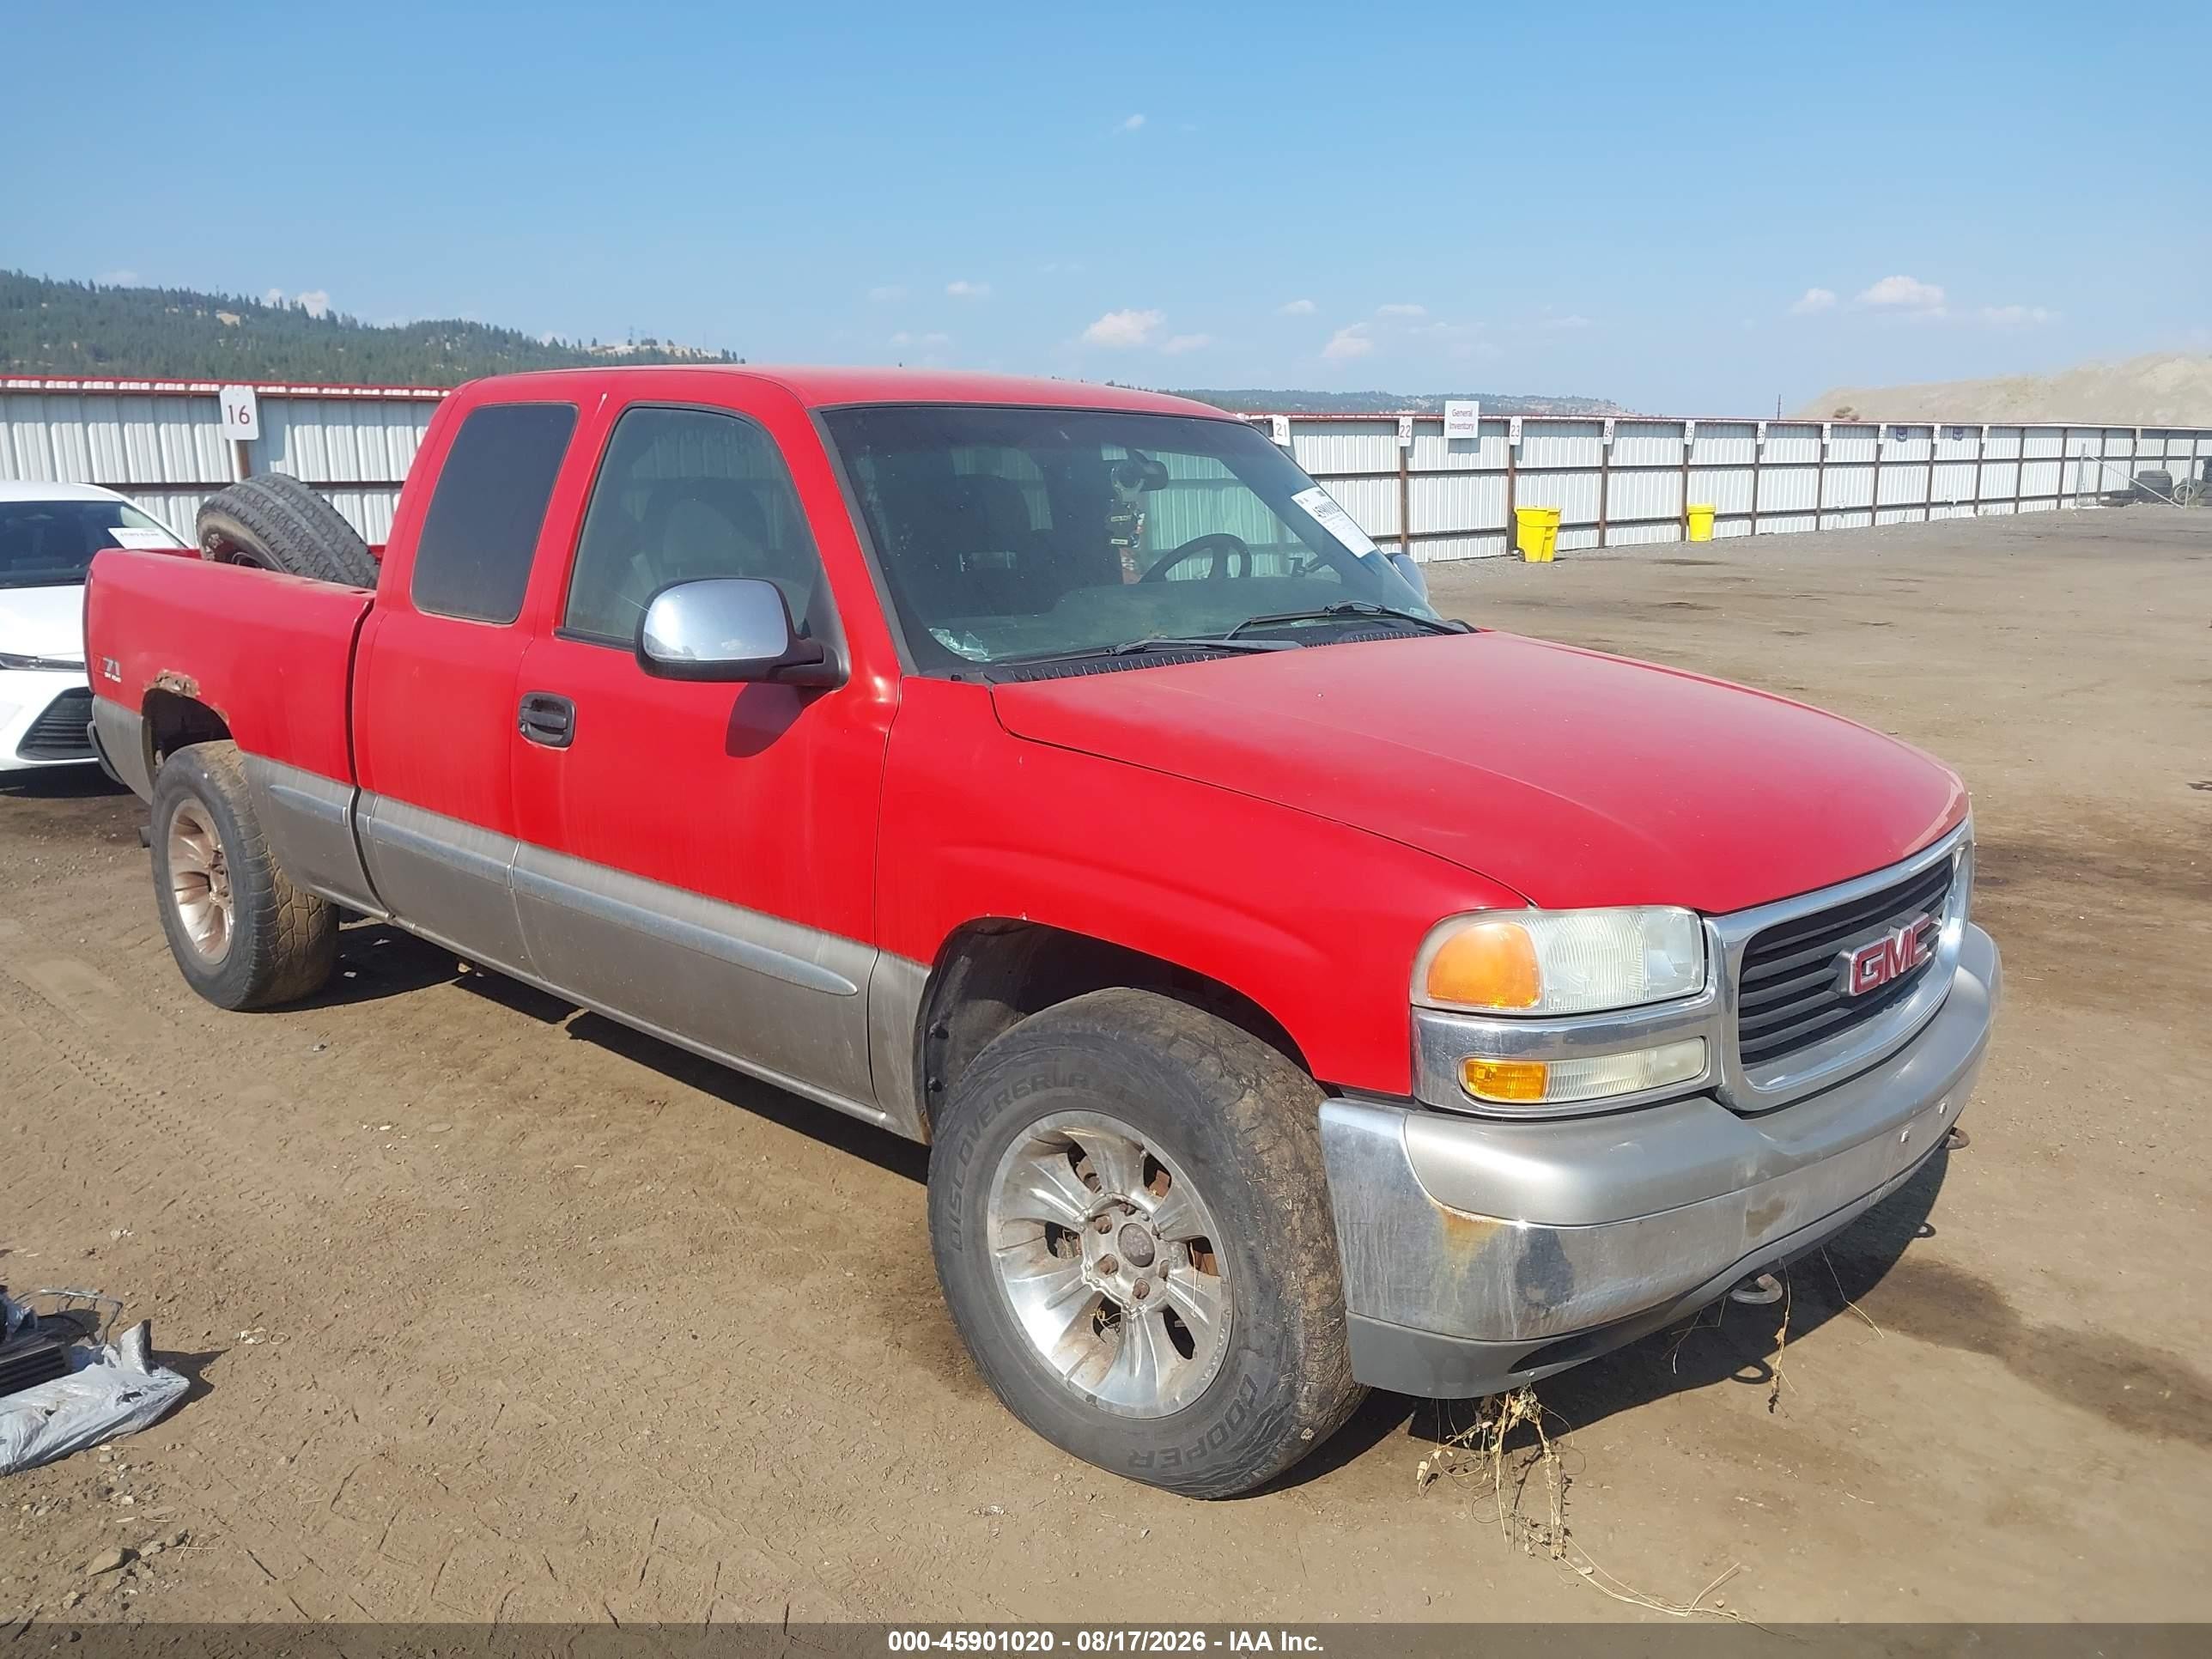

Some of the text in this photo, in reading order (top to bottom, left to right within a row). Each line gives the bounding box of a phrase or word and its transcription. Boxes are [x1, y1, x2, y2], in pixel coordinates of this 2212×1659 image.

[228, 404, 251, 425] 16
[1451, 409, 1474, 417] General
[1275, 422, 1287, 438] 21
[1400, 424, 1411, 438] 22
[1449, 422, 1475, 432] Inventory
[1510, 424, 1520, 437] 23
[1604, 426, 1613, 438] 24
[94, 653, 120, 677] Z71
[1850, 912, 1931, 996] GMC
[950, 1073, 1053, 1252] DISCOVERER
[1127, 1373, 1258, 1469] COOPER
